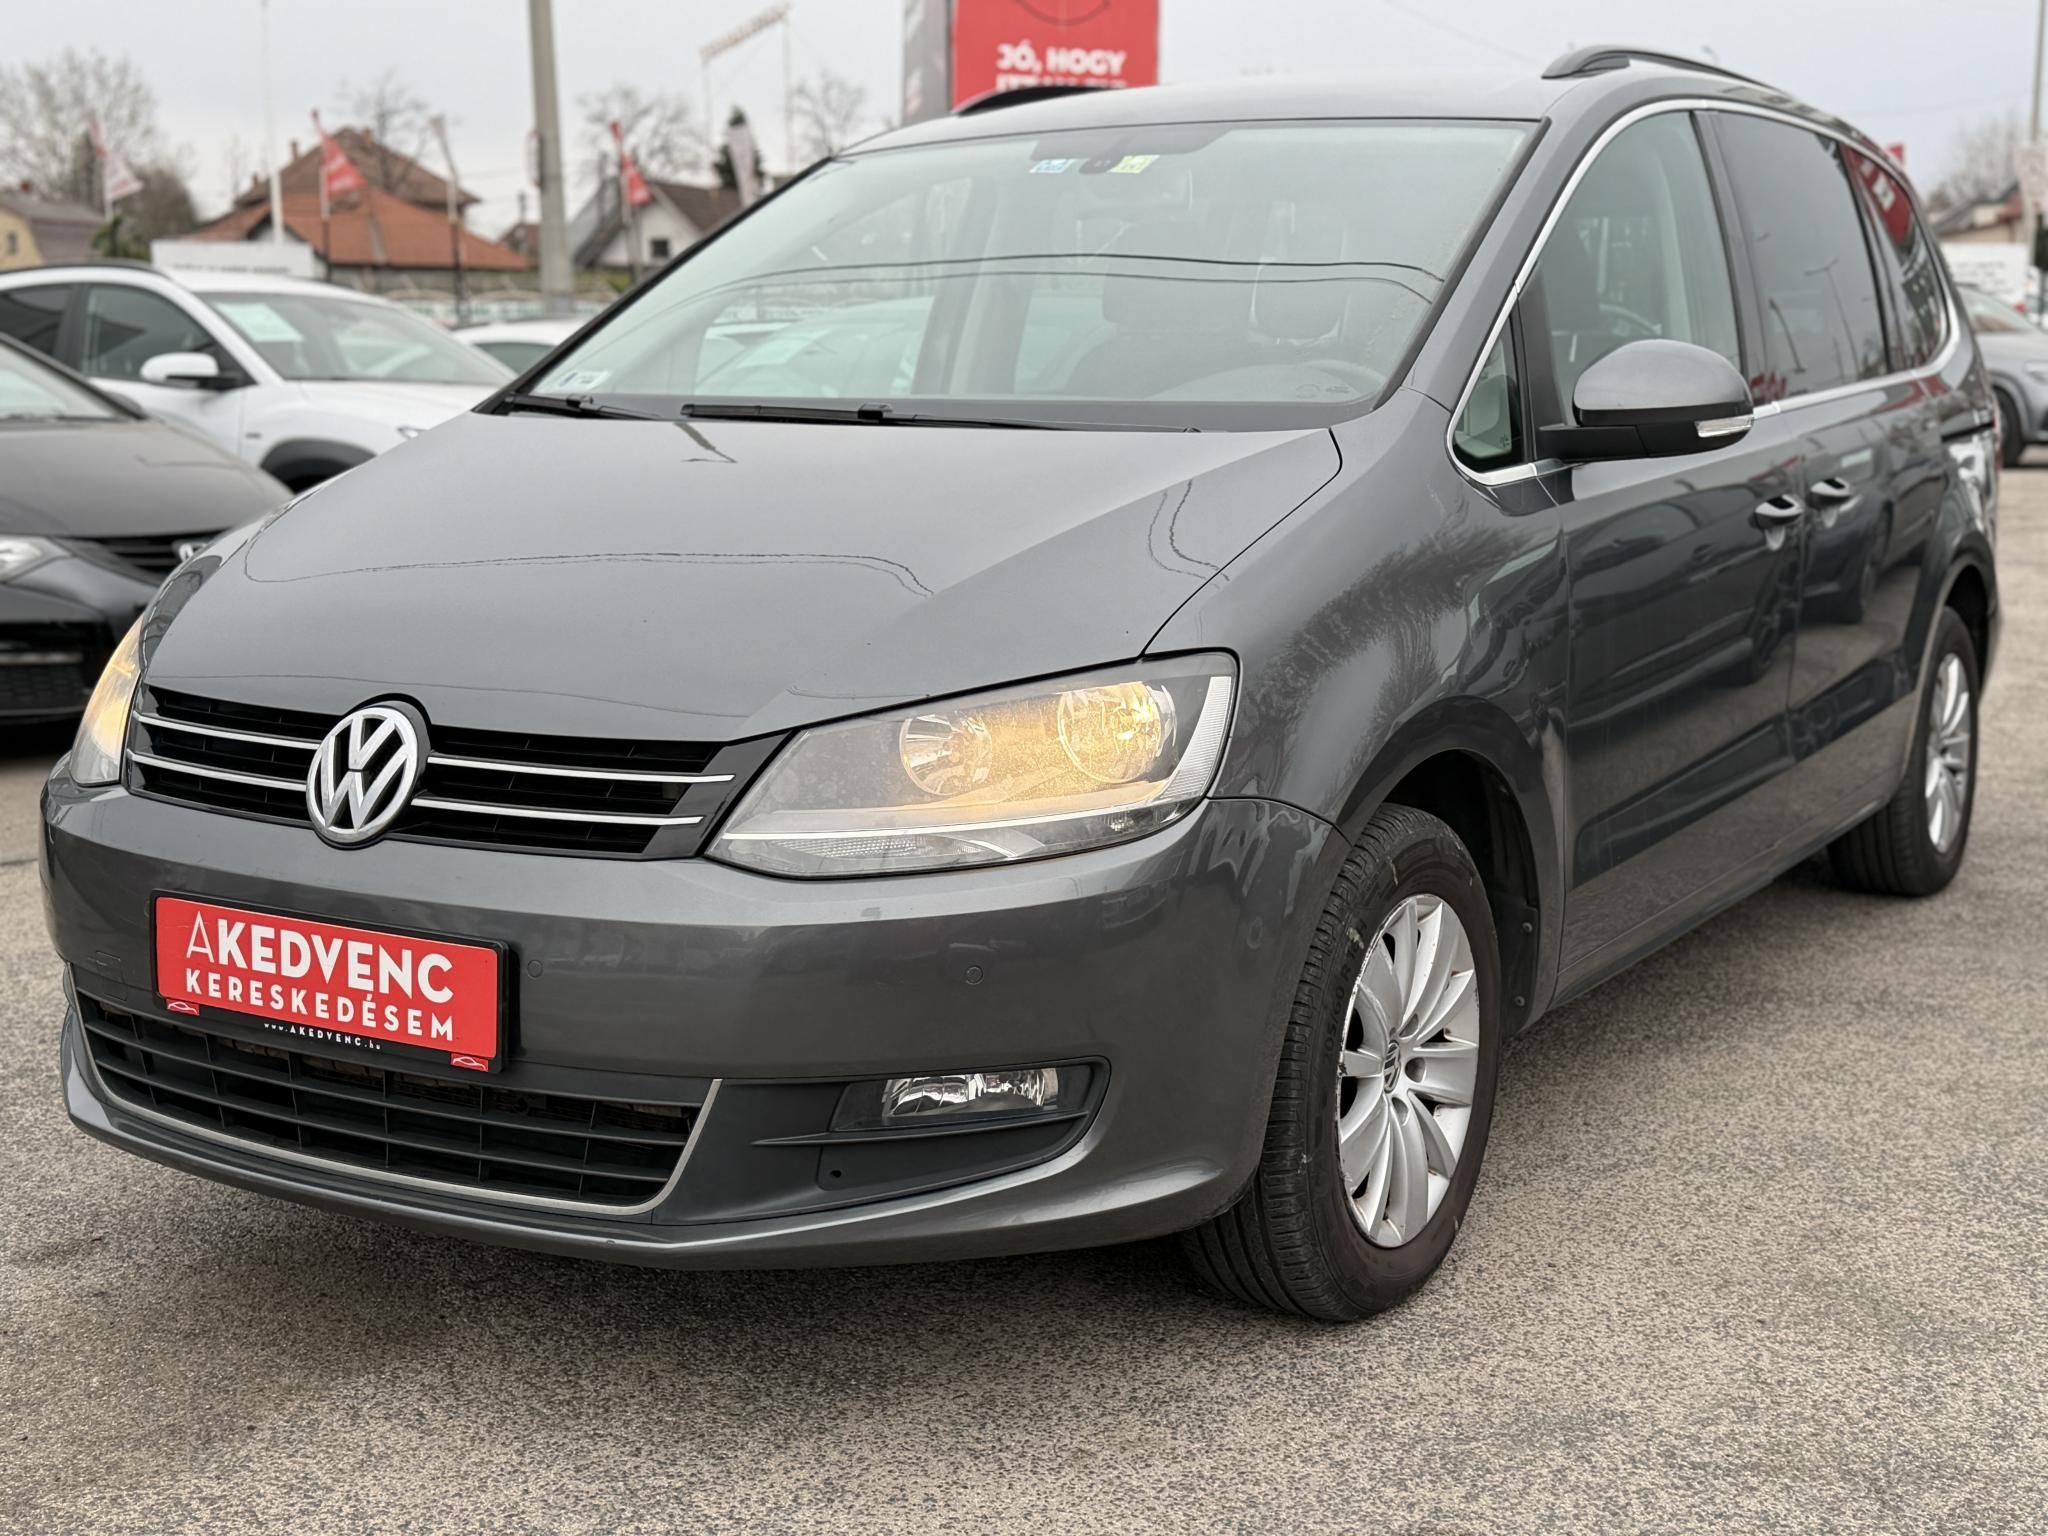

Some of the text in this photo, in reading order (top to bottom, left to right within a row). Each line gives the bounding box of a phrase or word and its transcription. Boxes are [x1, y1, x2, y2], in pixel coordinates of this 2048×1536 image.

[1045, 46, 1127, 77] HOGY
[185, 967, 454, 1042] KERESKEDÉSEM
[264, 1023, 381, 1050] www.AKEDVENC.hu
